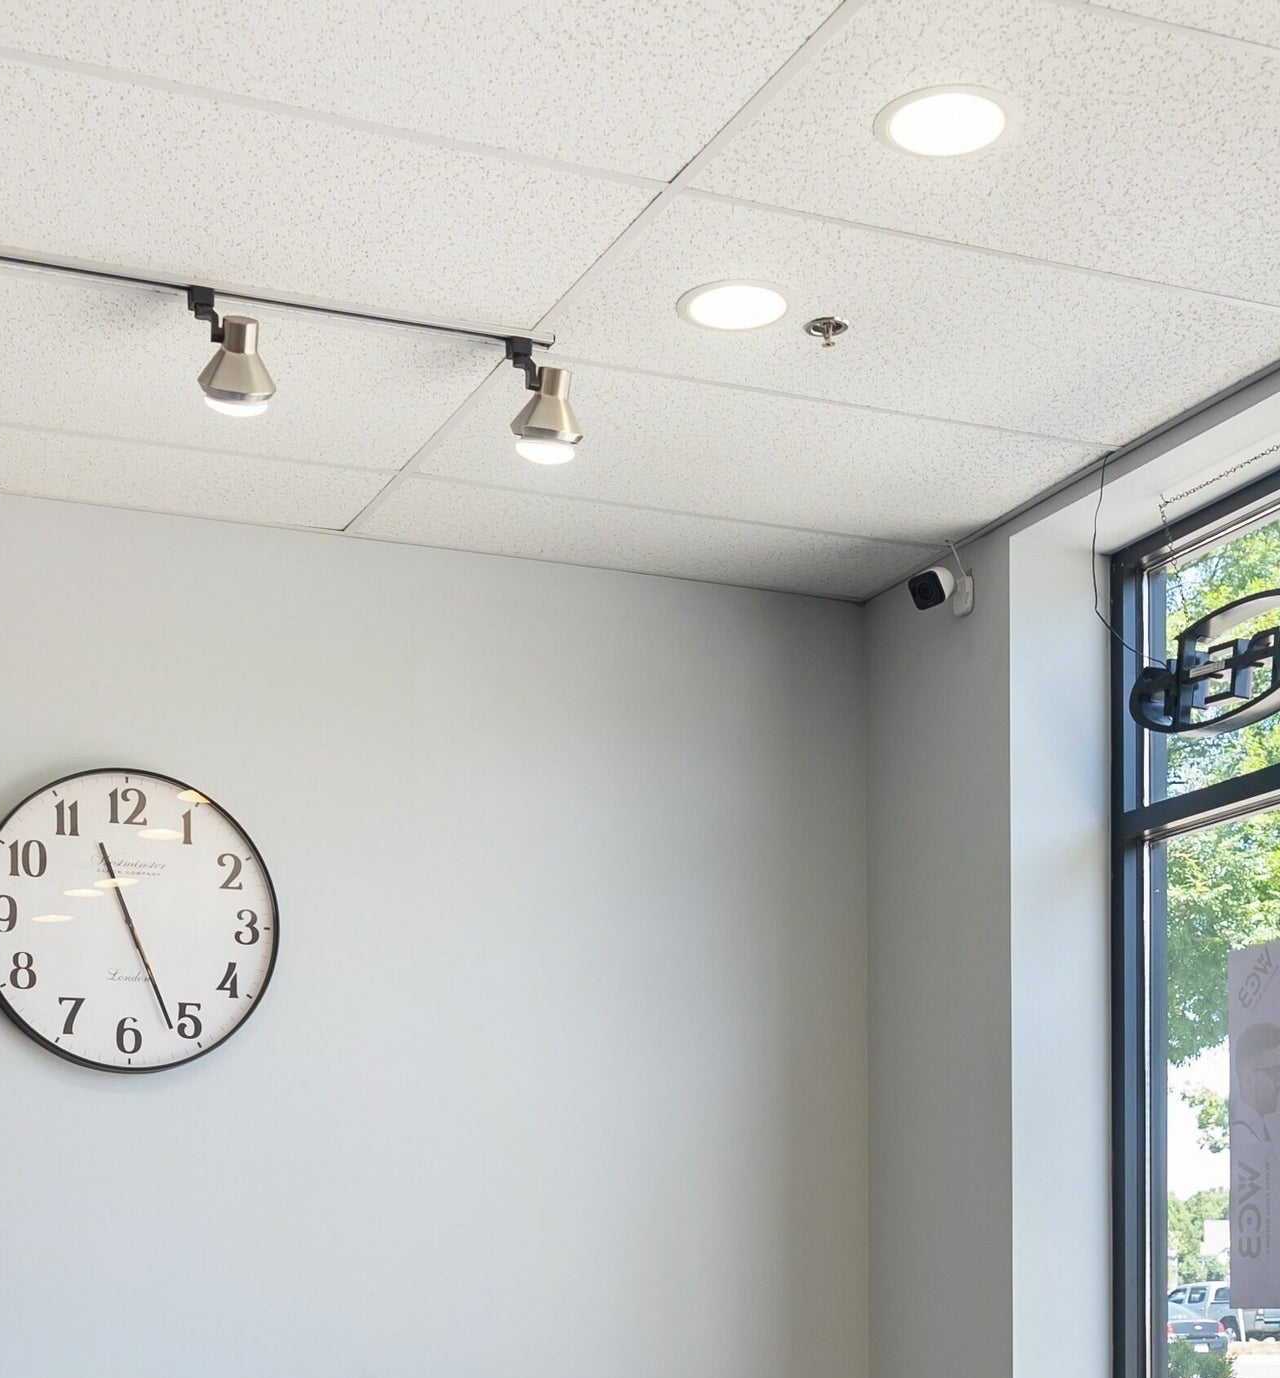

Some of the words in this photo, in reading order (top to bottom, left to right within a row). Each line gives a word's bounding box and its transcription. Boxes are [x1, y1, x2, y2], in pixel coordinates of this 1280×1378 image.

[54, 799, 80, 836] 11
[108, 787, 148, 825] 12
[181, 808, 193, 845] 1
[8, 839, 47, 877] 10
[217, 853, 243, 890] 2
[234, 908, 260, 945] 3
[9, 951, 37, 989] 8
[216, 961, 240, 998] 4
[58, 996, 86, 1035] 7
[176, 1001, 202, 1039] 5
[115, 1016, 142, 1054] 6
